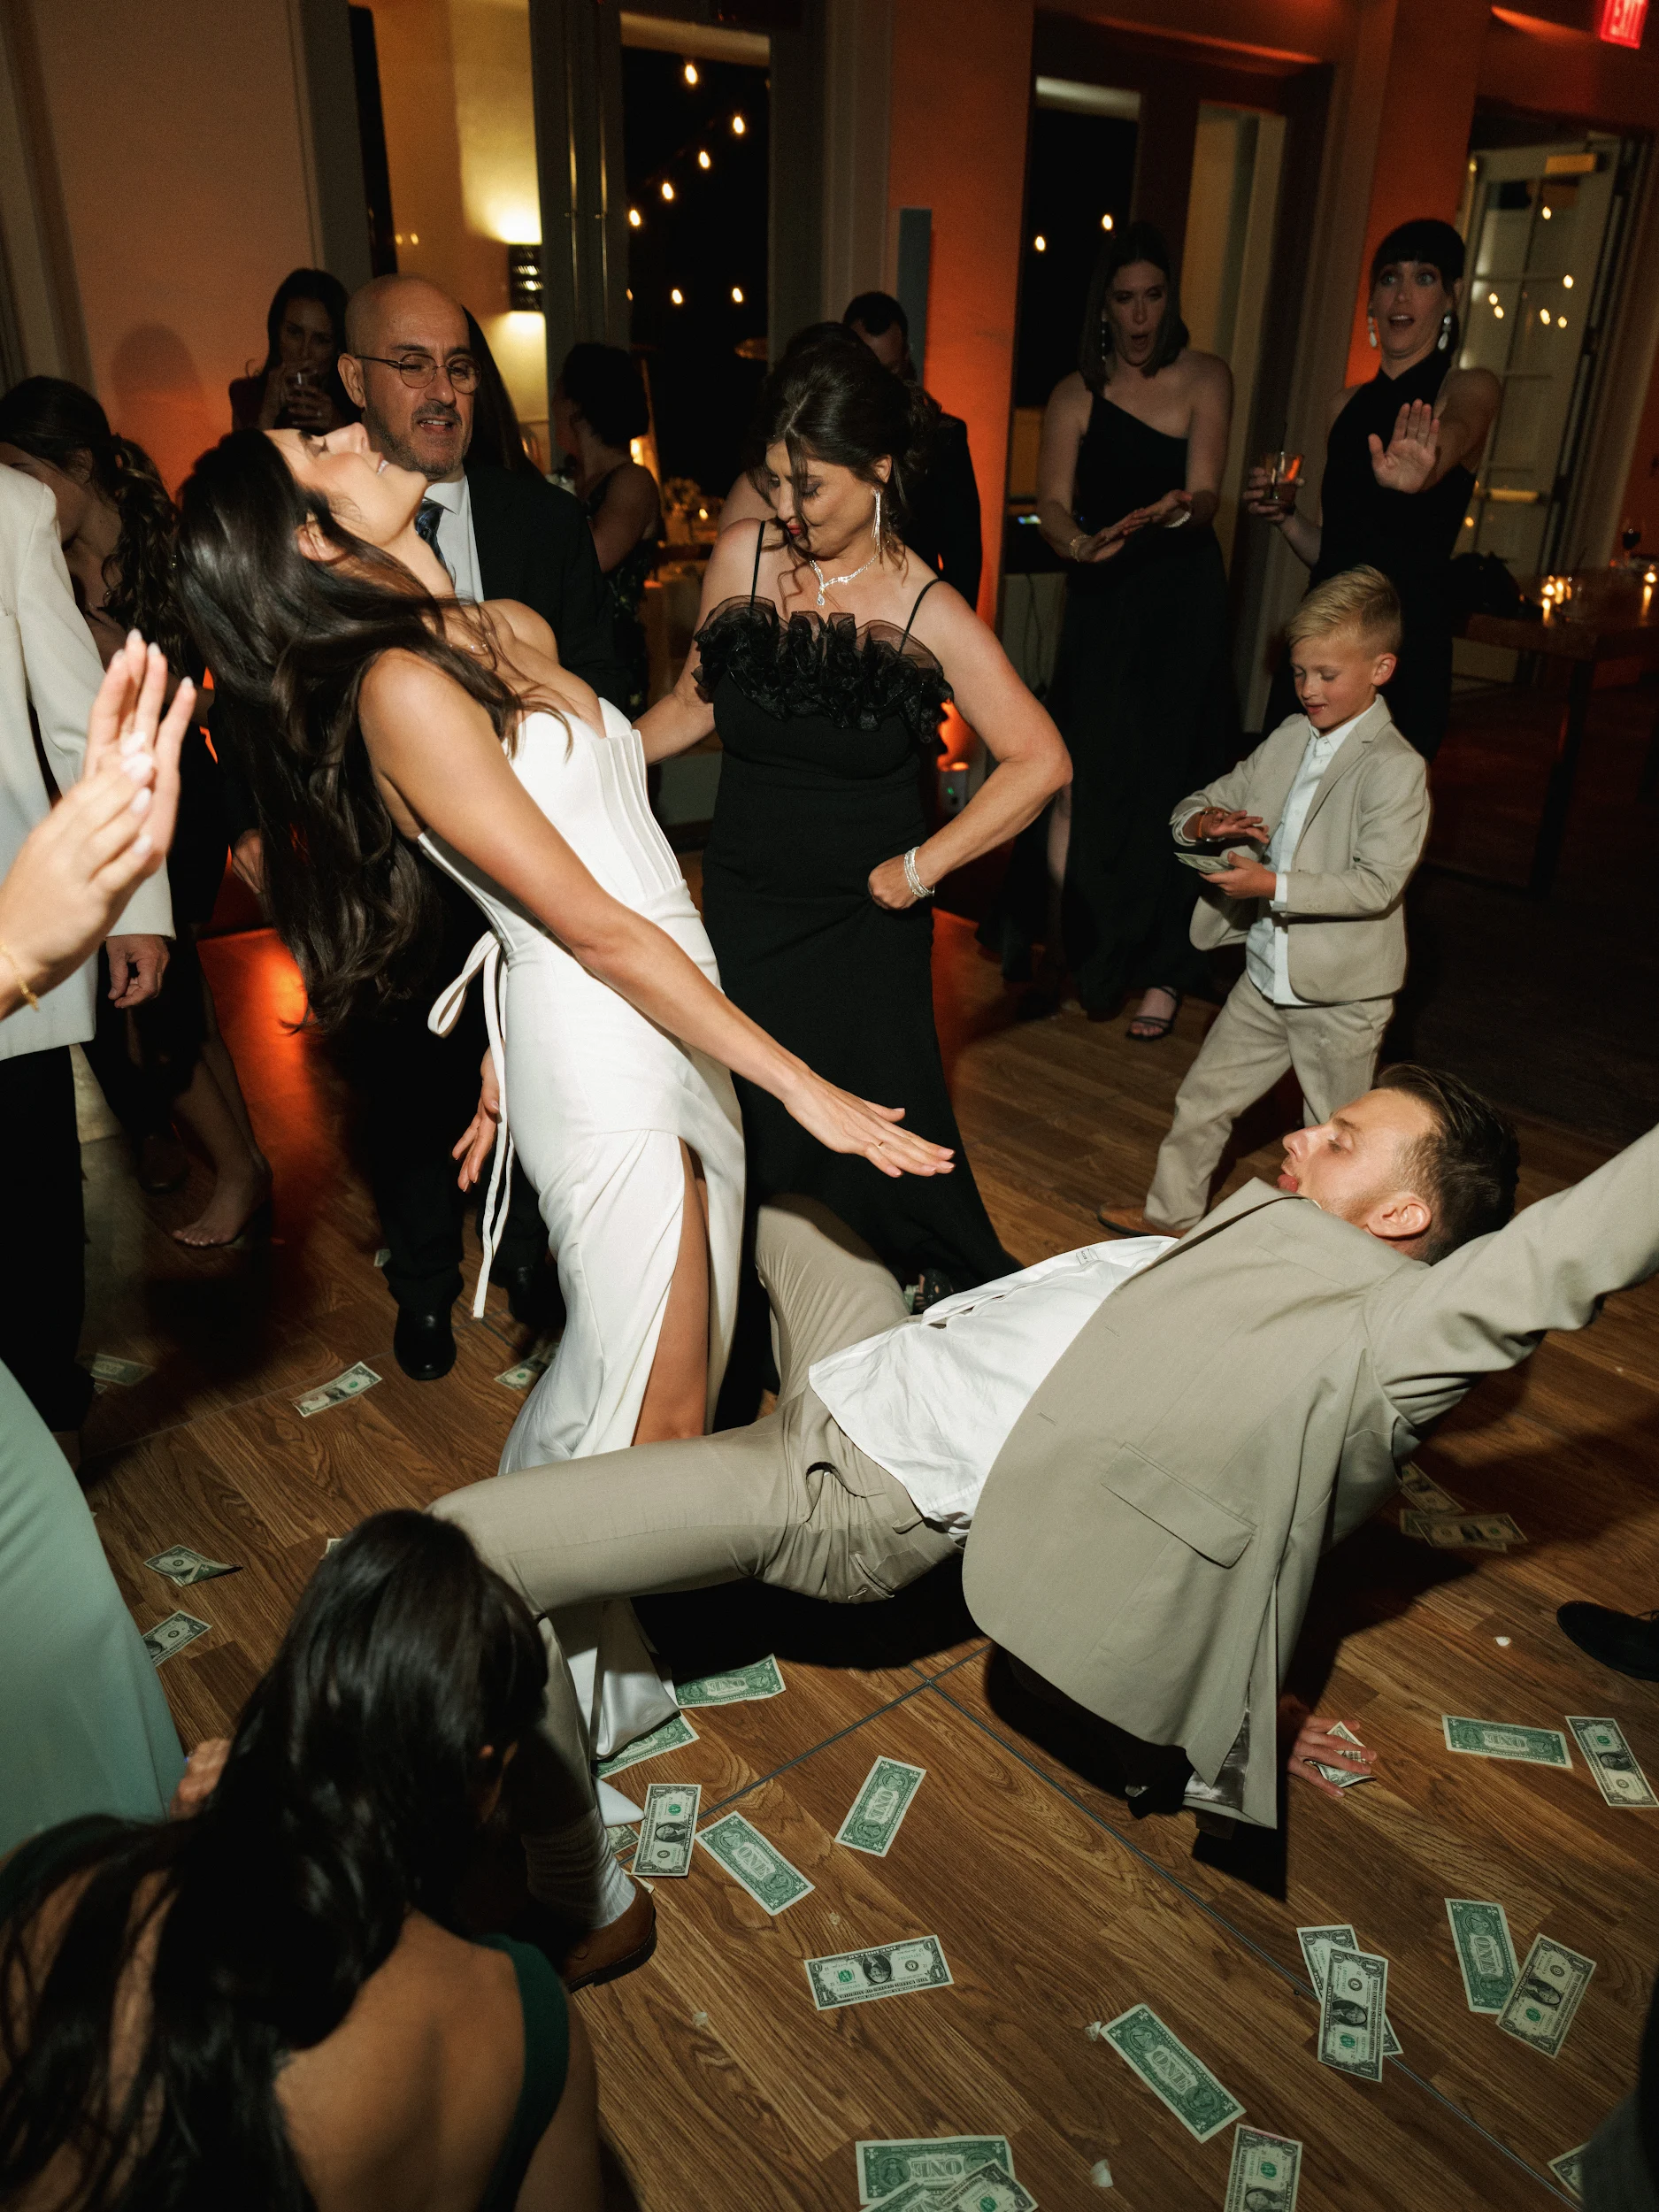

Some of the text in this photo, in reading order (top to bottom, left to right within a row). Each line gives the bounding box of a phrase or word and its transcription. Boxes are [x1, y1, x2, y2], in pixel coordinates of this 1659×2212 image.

[706, 1680, 745, 1692] ONE
[1485, 1732, 1525, 1747] ONE
[867, 1788, 895, 1820] ONE
[733, 1845, 772, 1878] ONE
[847, 1948, 880, 1959] DOLLAR
[1472, 1935, 1497, 1973] ONE
[838, 1989, 865, 1999] AMERICA
[1148, 2047, 1193, 2092] ONE
[911, 2158, 963, 2177] ONE
